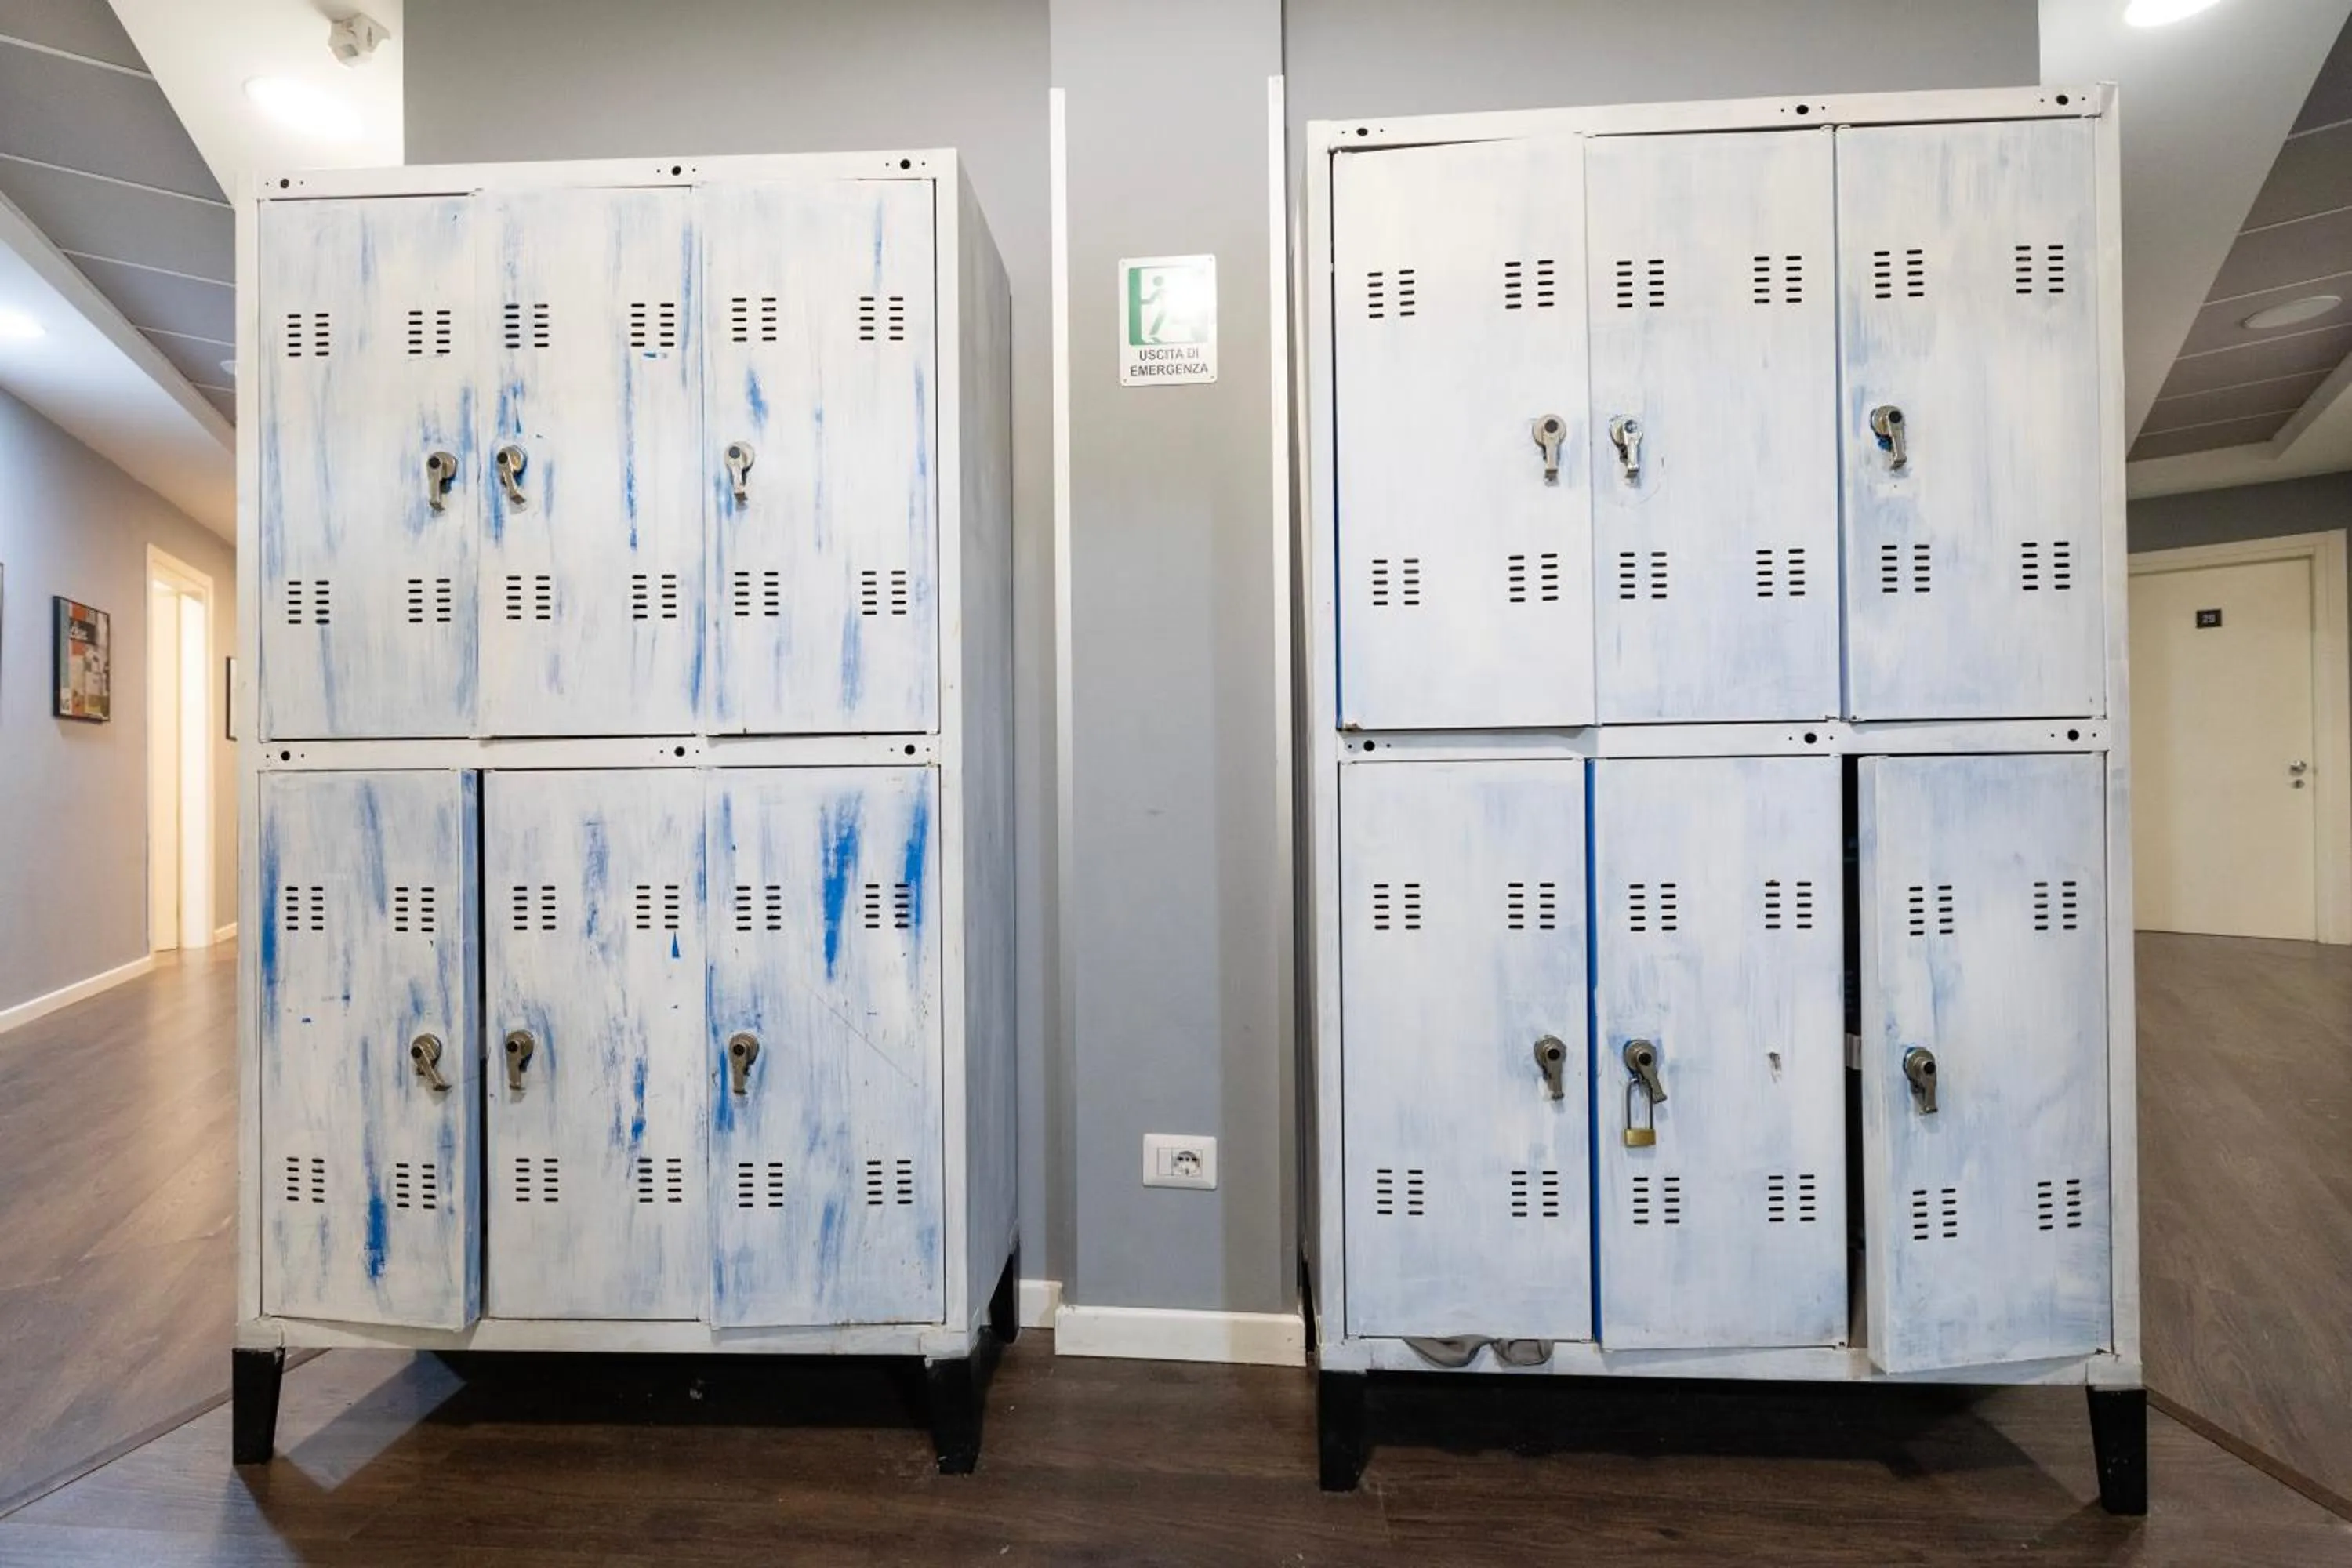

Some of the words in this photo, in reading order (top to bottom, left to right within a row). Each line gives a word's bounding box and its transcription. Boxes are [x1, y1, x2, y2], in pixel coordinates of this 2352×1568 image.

[1139, 348, 1184, 361] USCITA
[1186, 347, 1199, 359] DI
[1130, 363, 1208, 376] EMERGENZA
